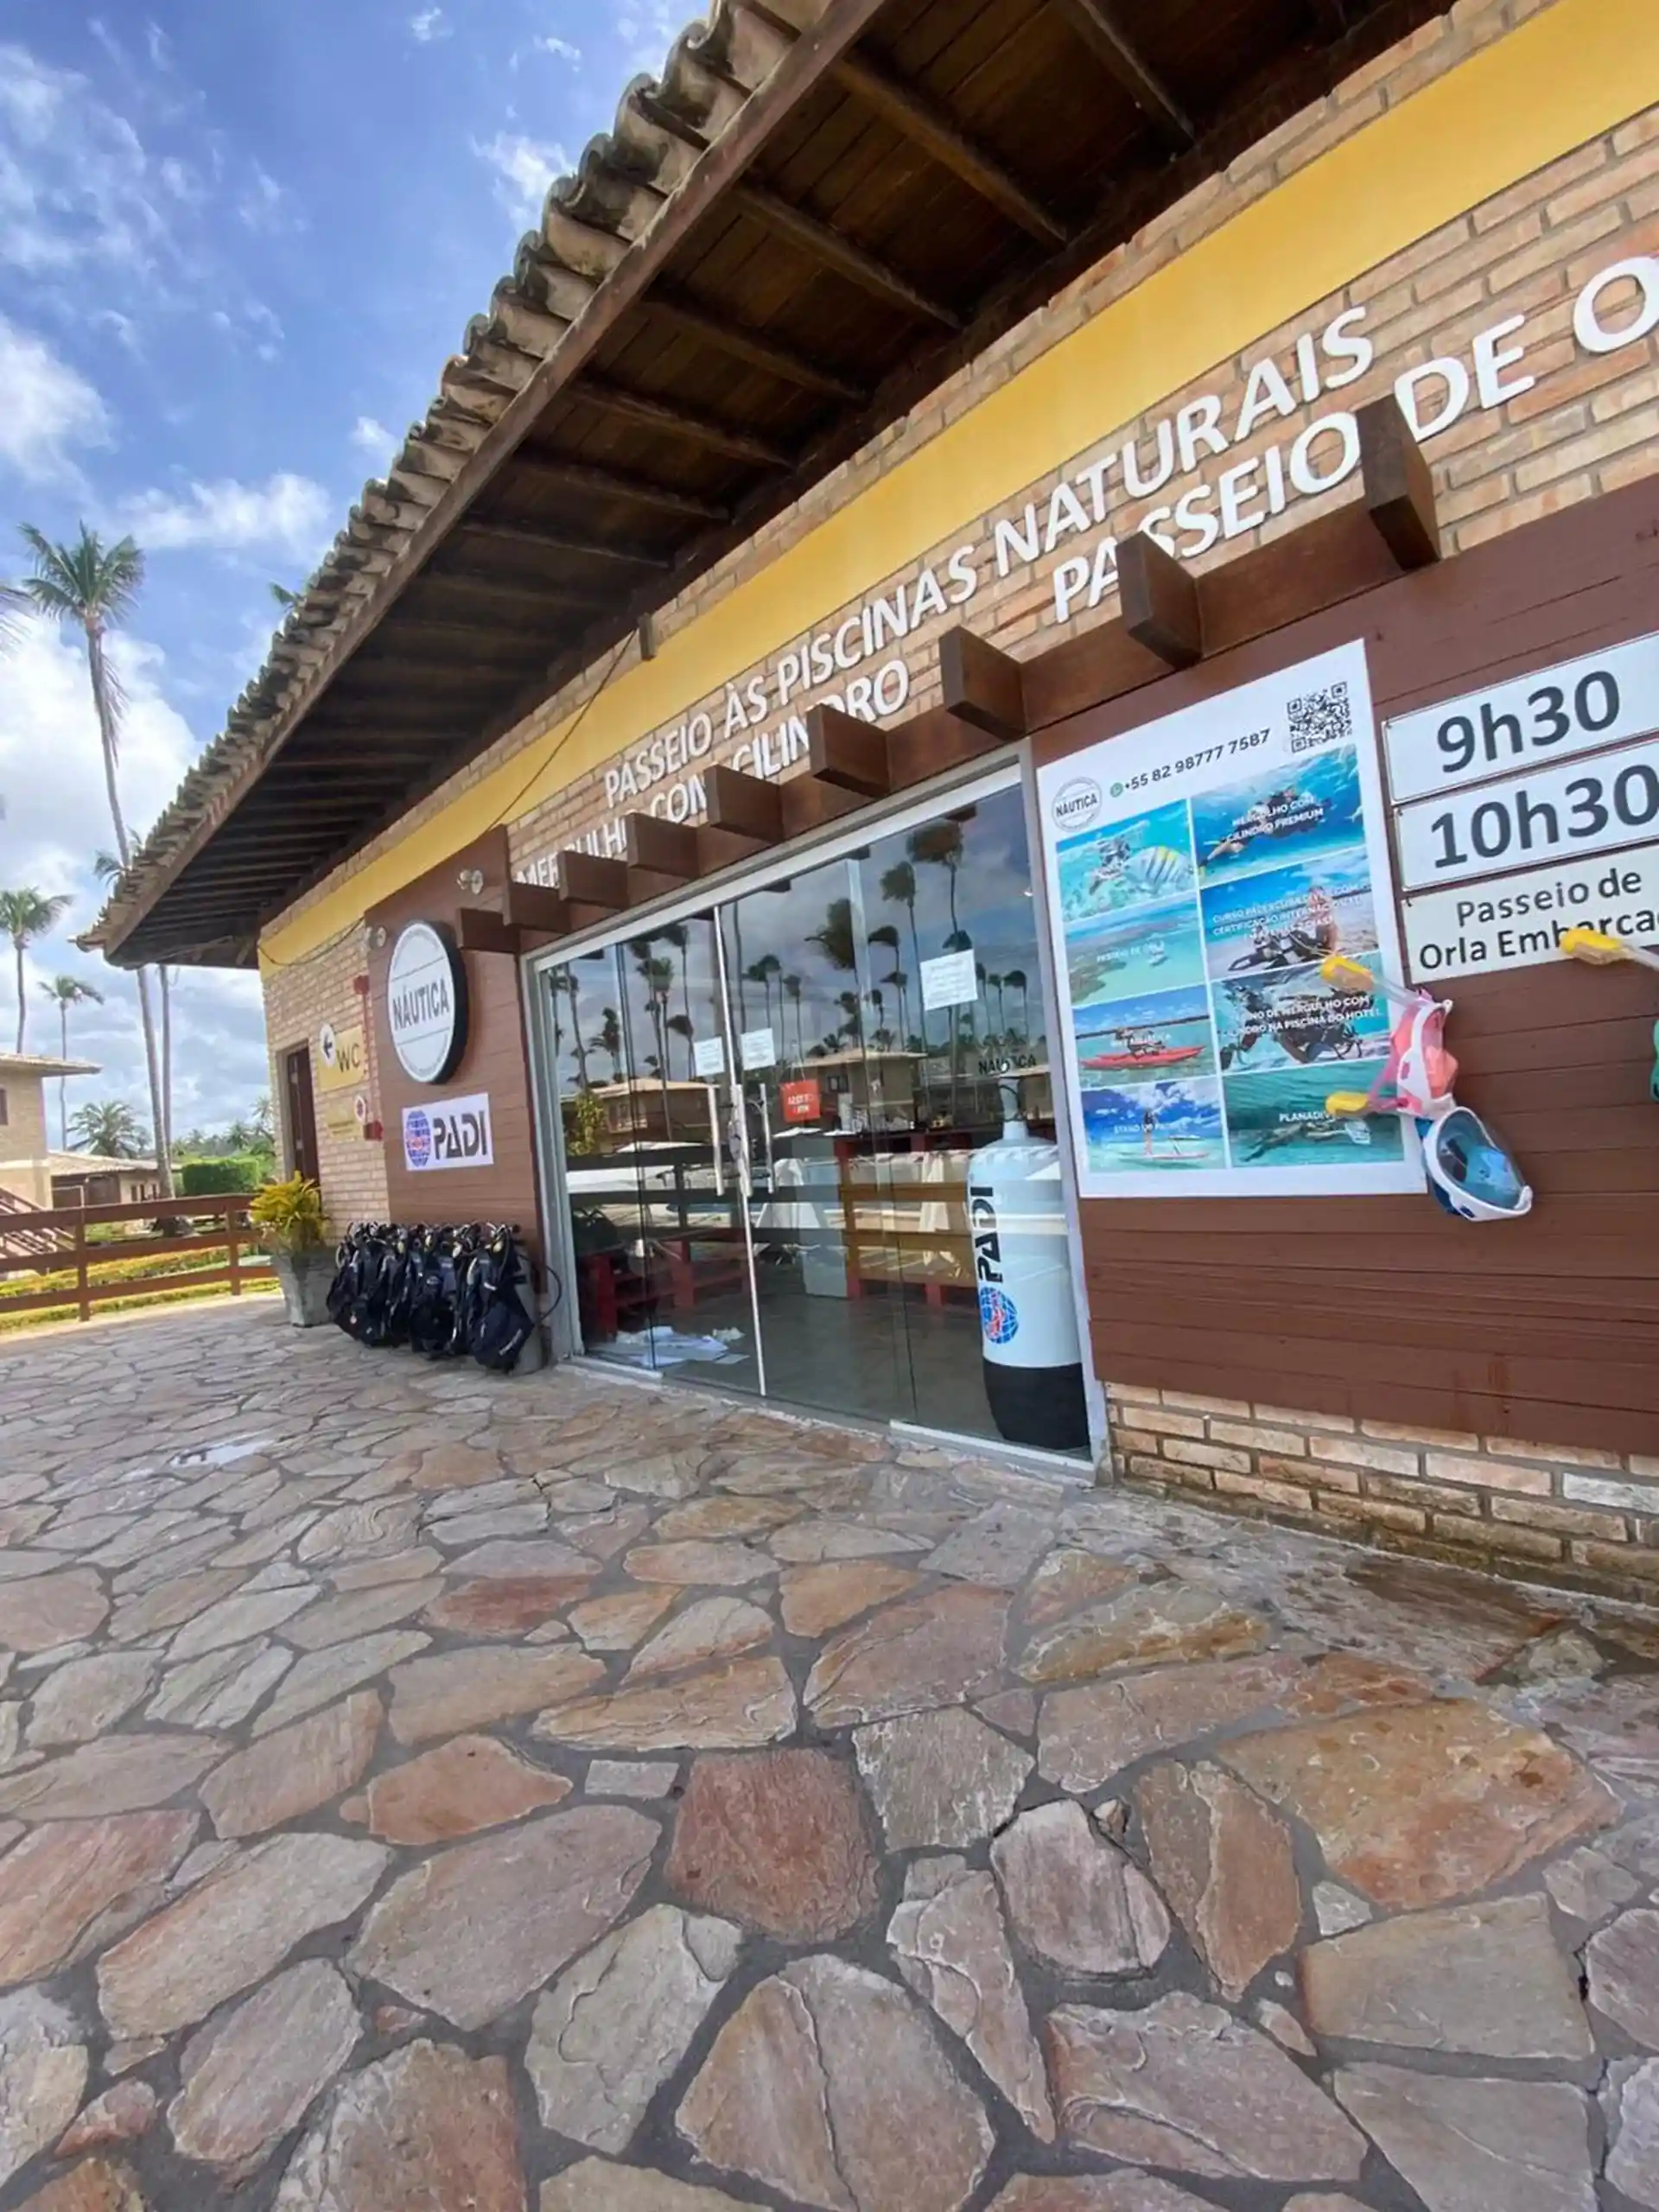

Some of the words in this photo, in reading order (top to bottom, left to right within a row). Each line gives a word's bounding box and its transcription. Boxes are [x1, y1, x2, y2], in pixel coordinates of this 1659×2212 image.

[1052, 410, 1362, 624] PASSEIO
[1394, 313, 1536, 442] DE
[603, 710, 713, 809] PASSEIO
[723, 674, 768, 740] ÀS
[777, 544, 978, 705] PISCINAS
[994, 305, 1375, 578] NATURAIS
[1152, 764, 1173, 782] 82
[1174, 744, 1224, 774] 98777
[1228, 728, 1271, 755] 7587
[1437, 670, 1620, 773] 9h30
[515, 809, 638, 887] MERULH
[1430, 763, 1659, 868] 10h30
[1456, 880, 1589, 927] Passeio
[1598, 868, 1642, 899] de
[1420, 937, 1487, 970] Orla
[336, 1042, 360, 1072] WC
[433, 1109, 488, 1160] PADI
[969, 1186, 1004, 1283] PADI
